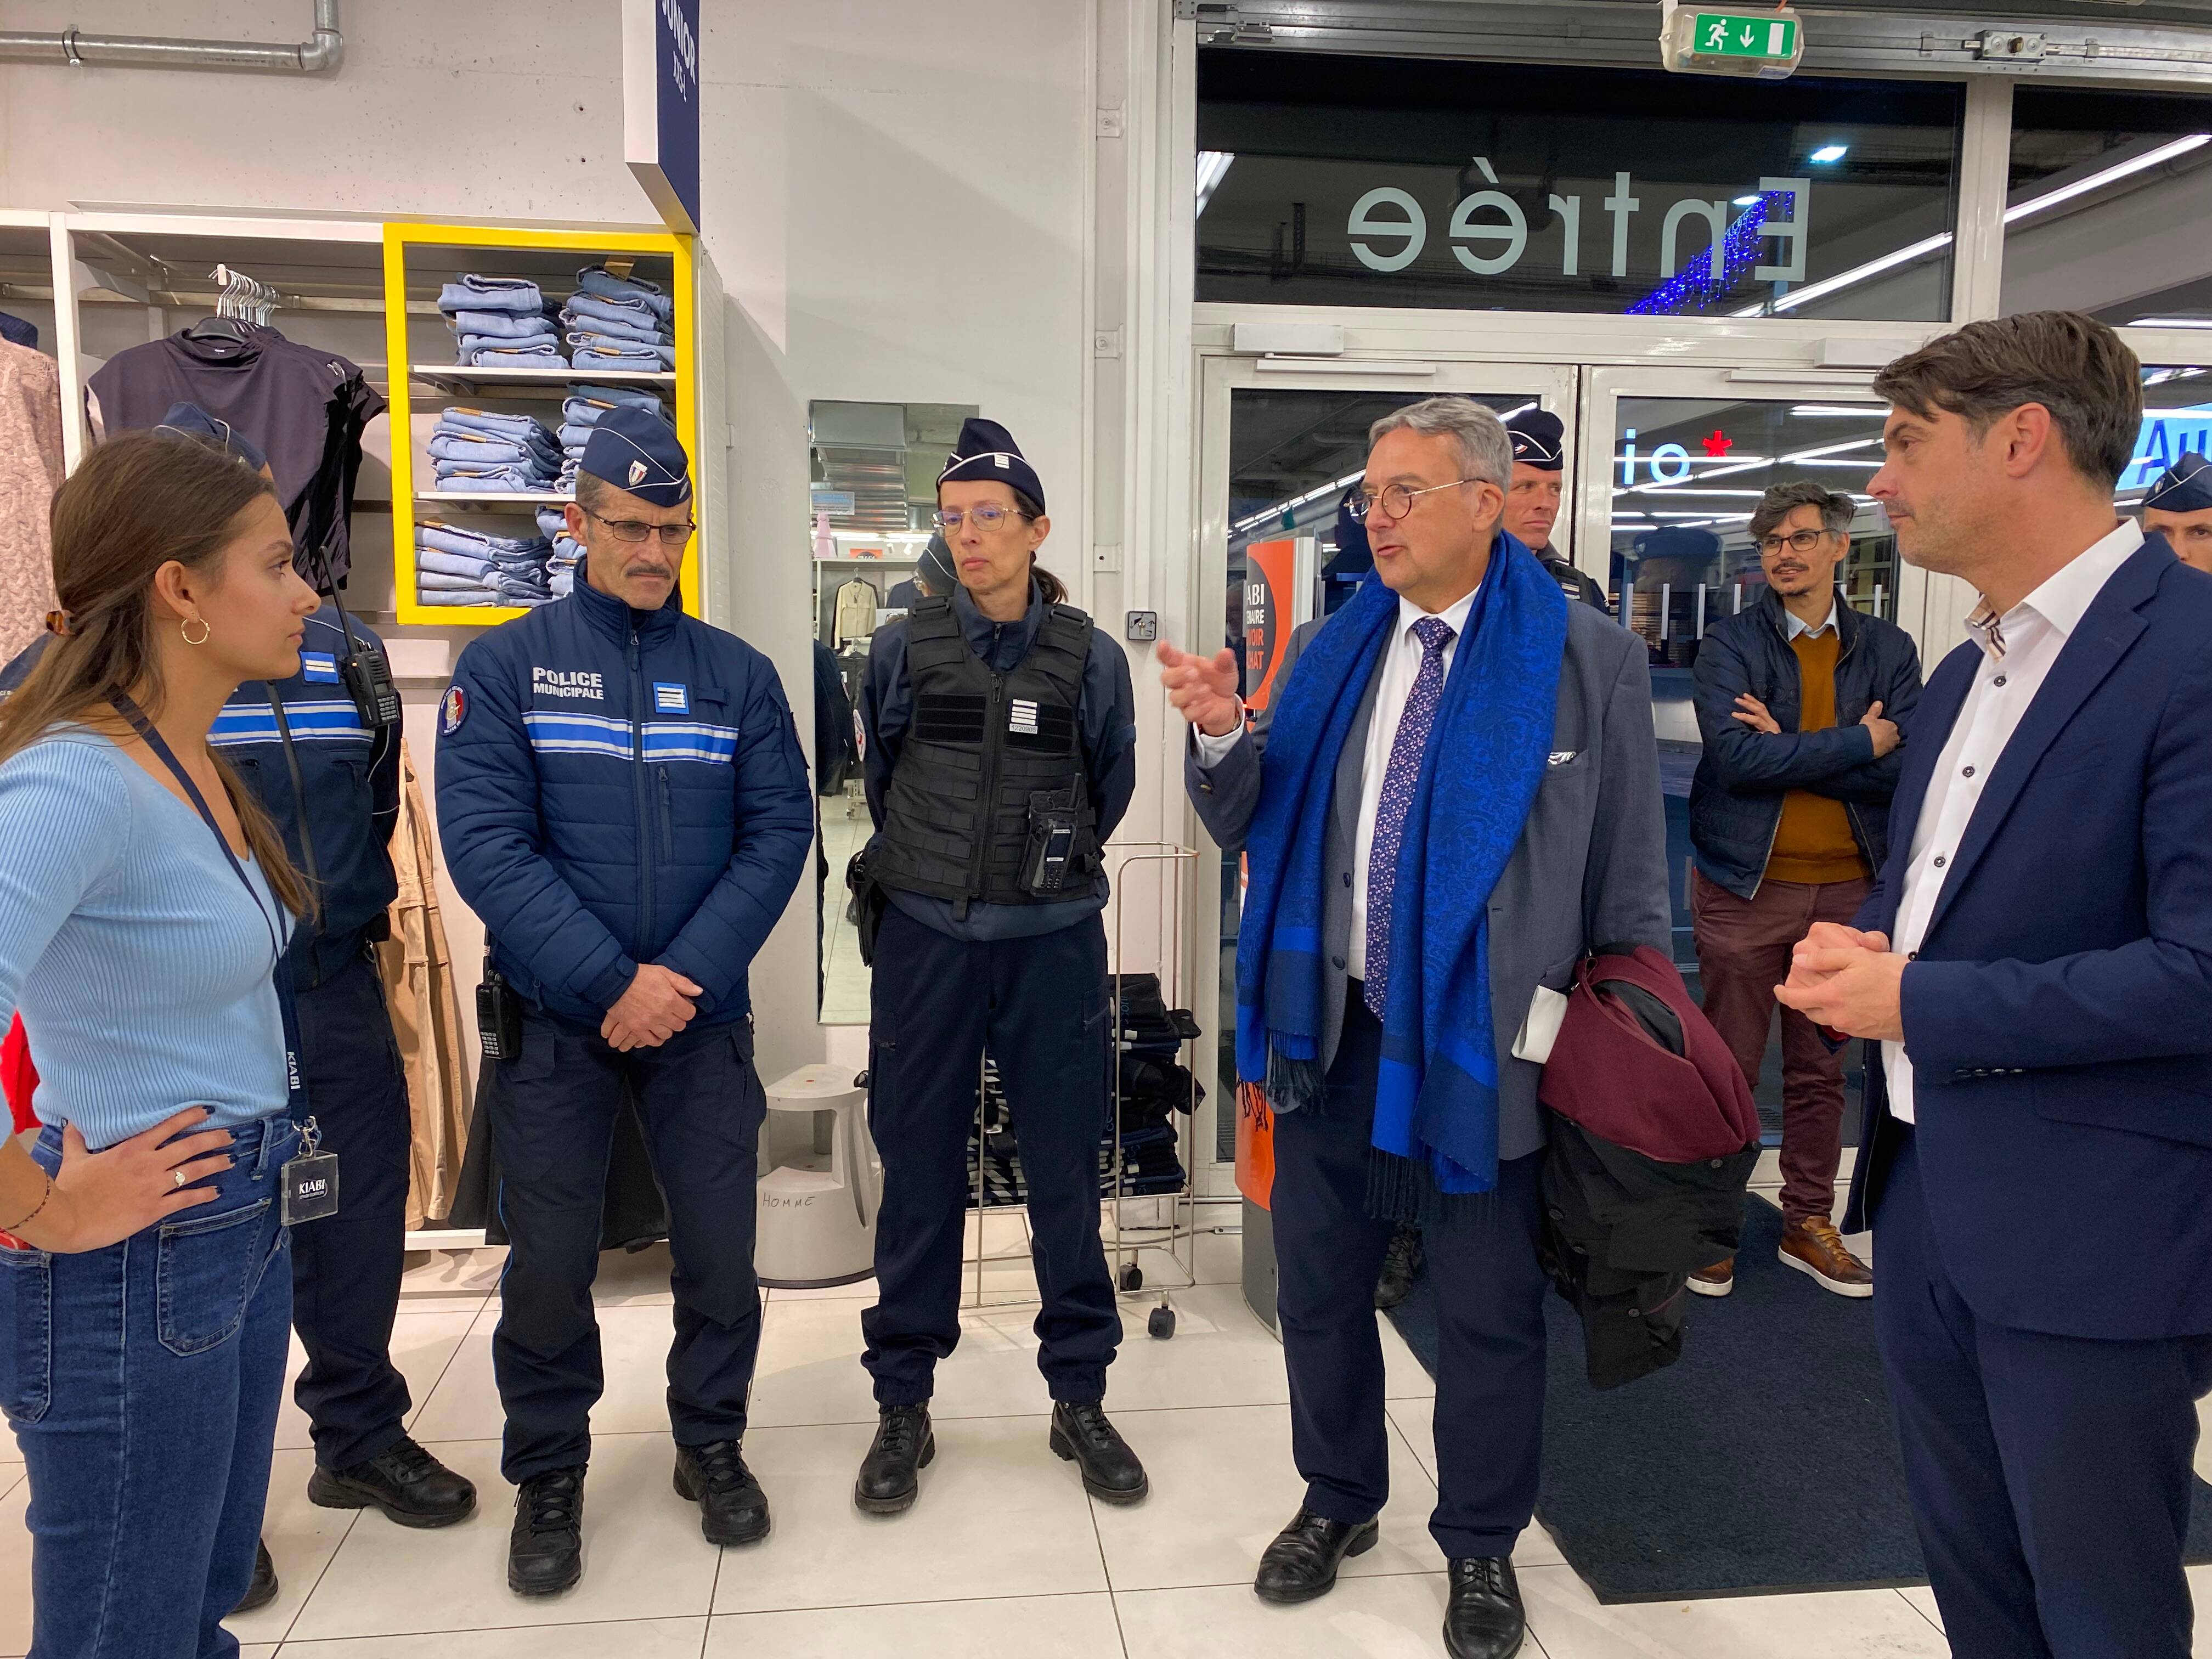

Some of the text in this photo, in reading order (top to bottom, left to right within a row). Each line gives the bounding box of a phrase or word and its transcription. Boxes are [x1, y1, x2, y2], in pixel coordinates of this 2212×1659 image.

[2136, 419, 2212, 484] Au
[532, 667, 603, 688] POLICE
[533, 682, 604, 700] MUNICIPALE
[287, 1051, 301, 1090] KIABI
[299, 1178, 325, 1195] KIABI
[763, 1192, 816, 1208] HOMME
